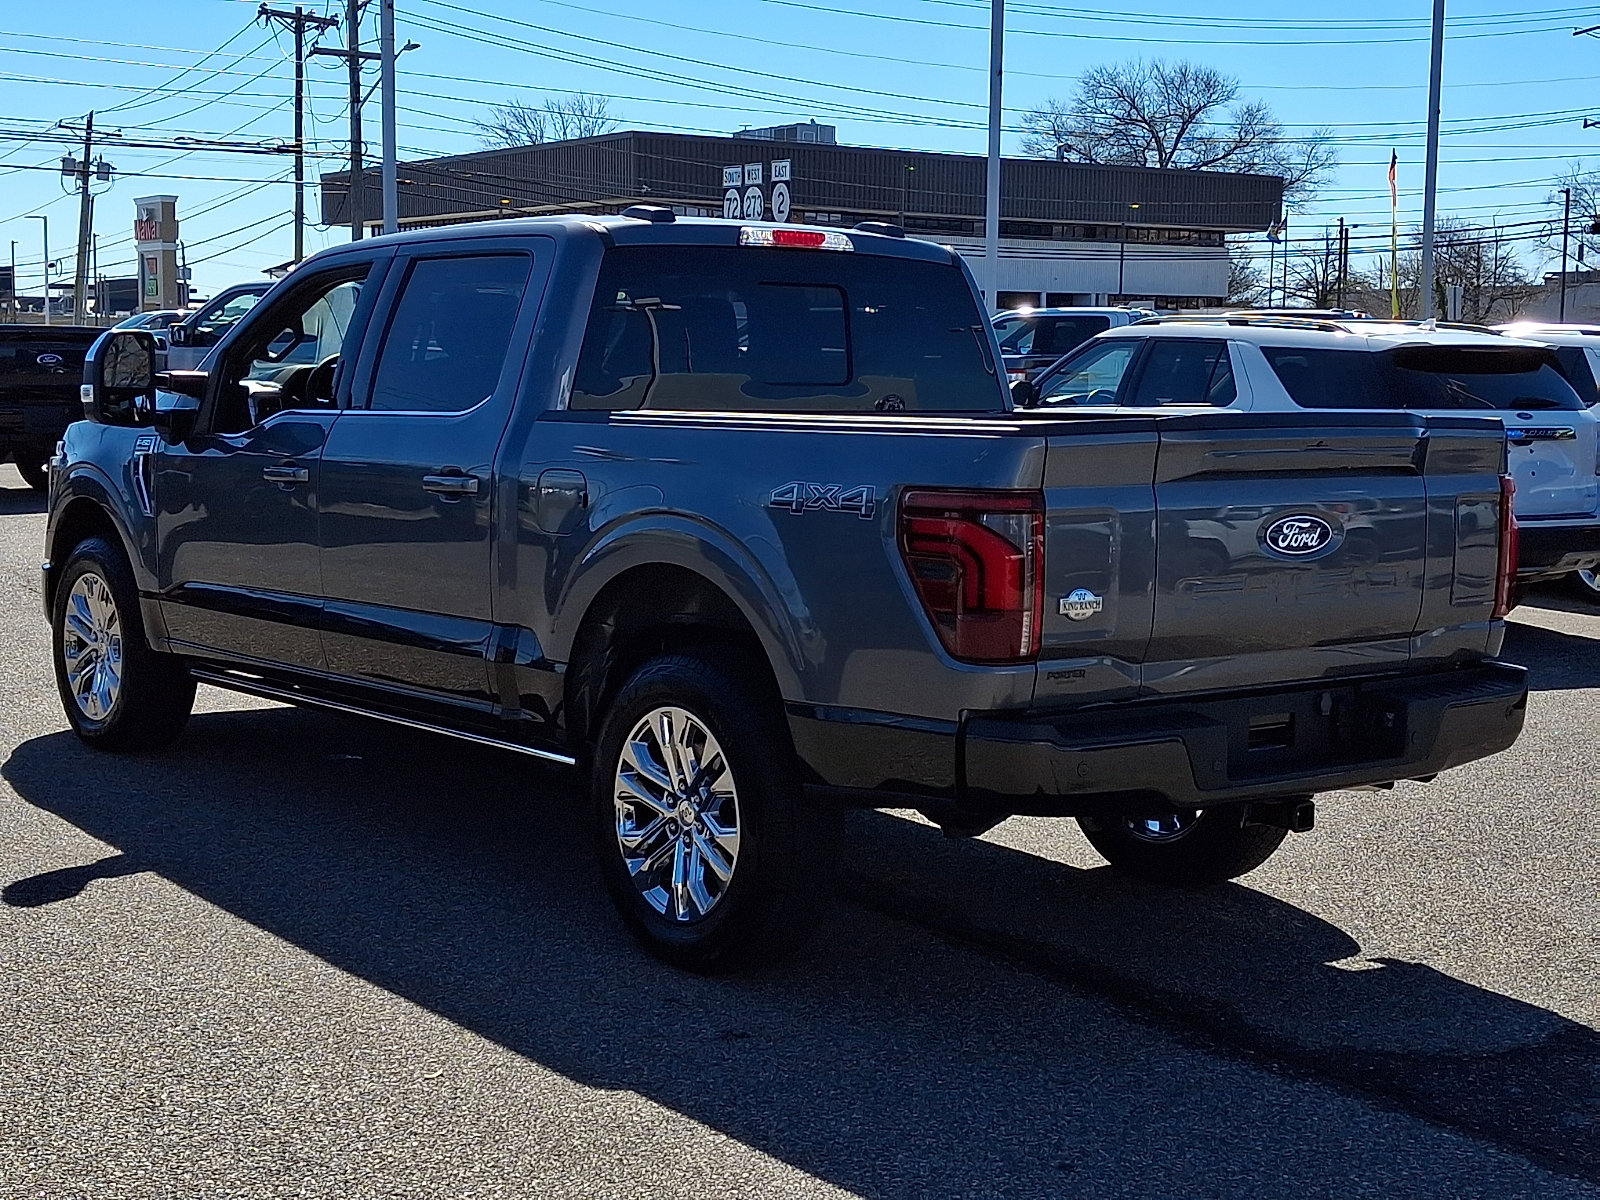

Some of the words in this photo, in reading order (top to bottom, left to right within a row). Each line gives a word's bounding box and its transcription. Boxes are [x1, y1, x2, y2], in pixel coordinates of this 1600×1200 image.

[724, 170, 741, 183] SOUTH
[747, 168, 760, 180] WEST
[774, 165, 788, 178] EAST
[725, 197, 739, 218] 72
[745, 195, 763, 218] 273
[777, 191, 785, 214] 2
[1278, 521, 1321, 548] Ford
[1063, 601, 1079, 612] KING
[1080, 600, 1101, 611] RANCH
